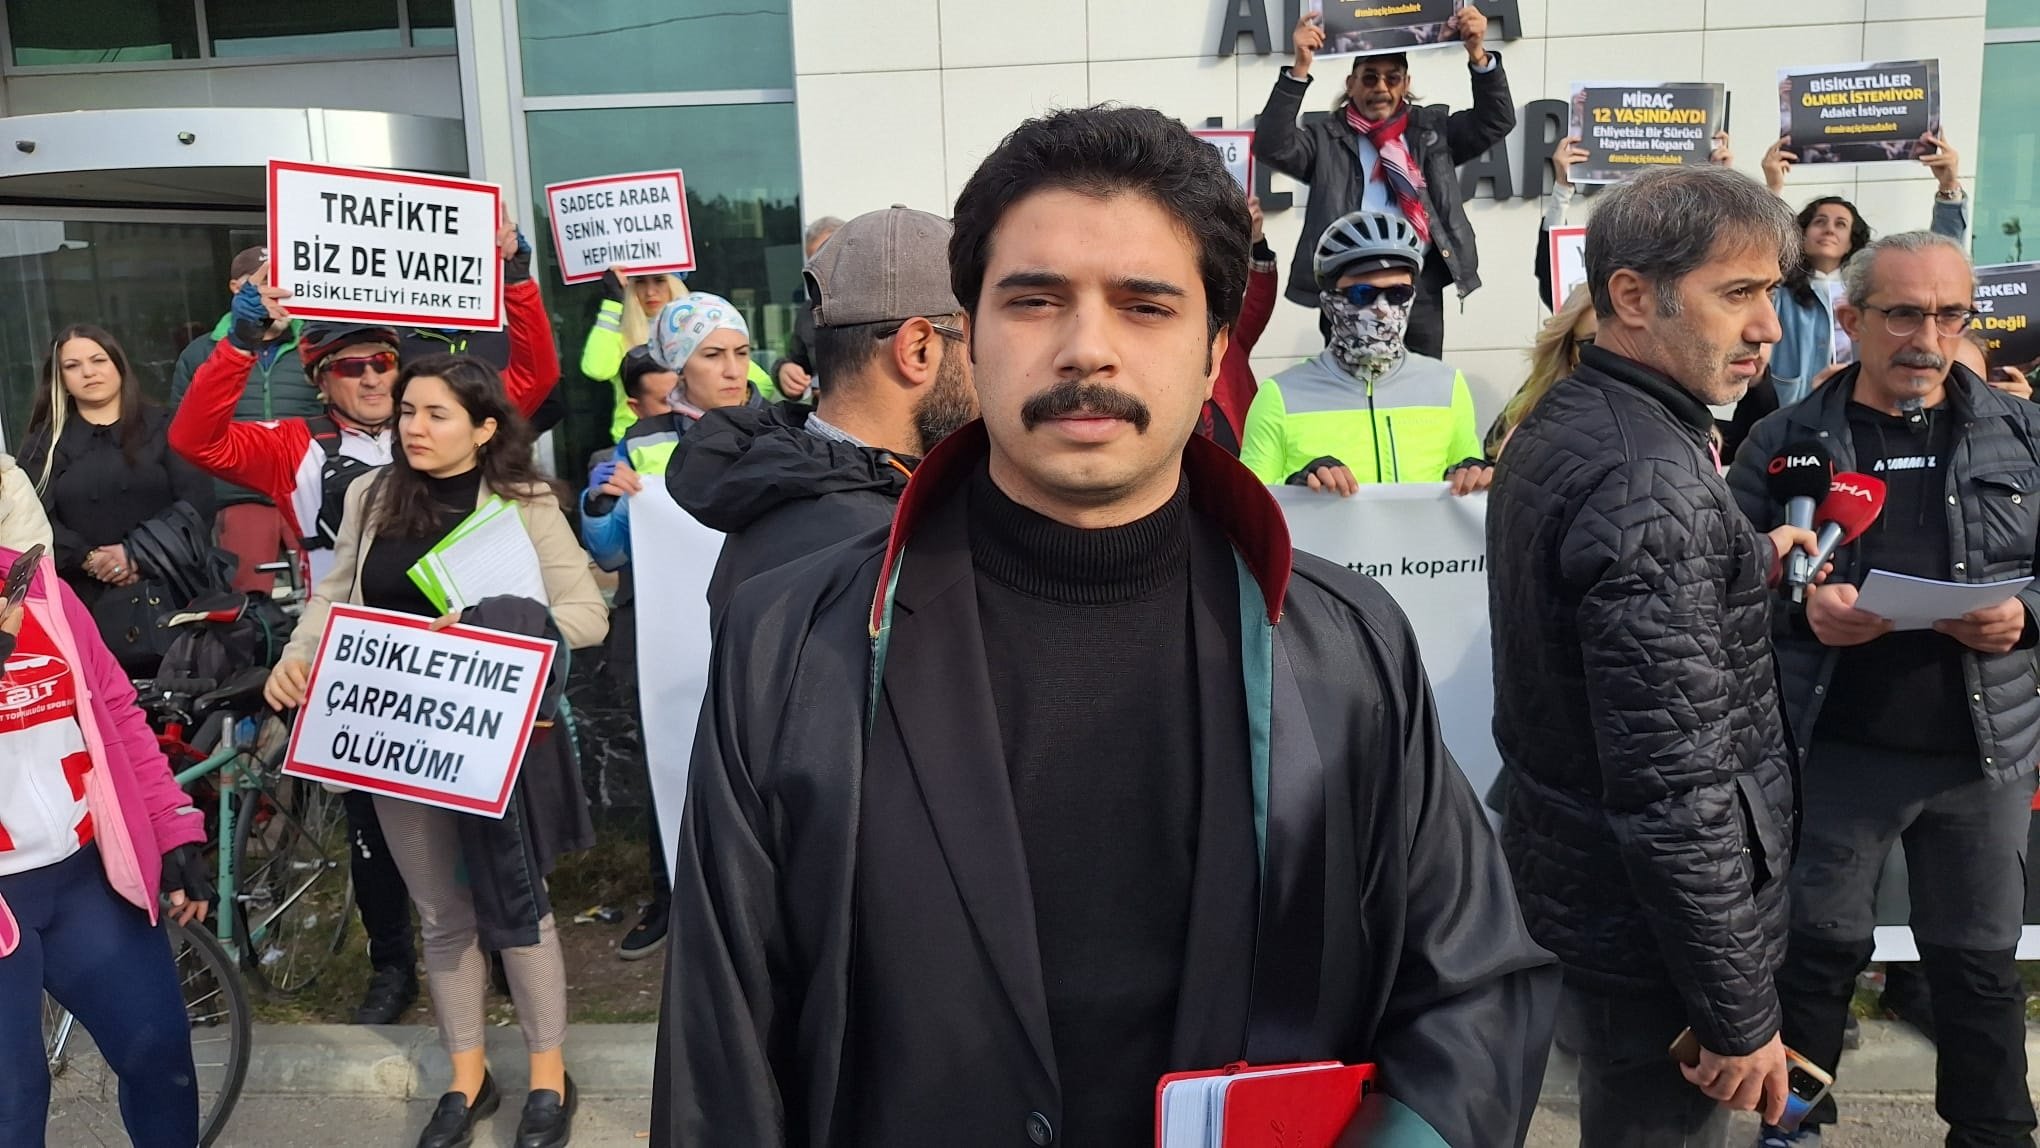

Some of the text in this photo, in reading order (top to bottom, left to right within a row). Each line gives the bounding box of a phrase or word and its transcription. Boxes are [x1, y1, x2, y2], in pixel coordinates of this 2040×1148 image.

[1810, 73, 1912, 93] BİSİKLETLİLER
[1622, 90, 1674, 110] MİRAÇ
[1802, 87, 1924, 107] ÖLMEK İSTEMİYOR
[1593, 108, 1707, 125] 12 YAŞINDAYDI
[1820, 104, 1908, 119] Adalet İstiyoruz
[1593, 126, 1703, 139] Ehliyetsiz Bir Sürücü
[1600, 138, 1694, 152] Hayattan Kopardı
[320, 192, 459, 235] TRAFİKTE
[560, 186, 671, 214] SADECE ARABA
[565, 214, 674, 241] SENİN. YOLLAR
[293, 235, 482, 285] BİZ DE VARIZ!
[582, 238, 662, 266] HEPİMİZİN!
[294, 281, 482, 310] BİSİKLETLİYİ FARK ET!
[1985, 315, 2027, 331] Değil
[334, 629, 525, 694] BİSİKLETİME
[325, 681, 503, 740] ÇARPARSAN
[331, 724, 465, 784] ÖLÜRÜM!
